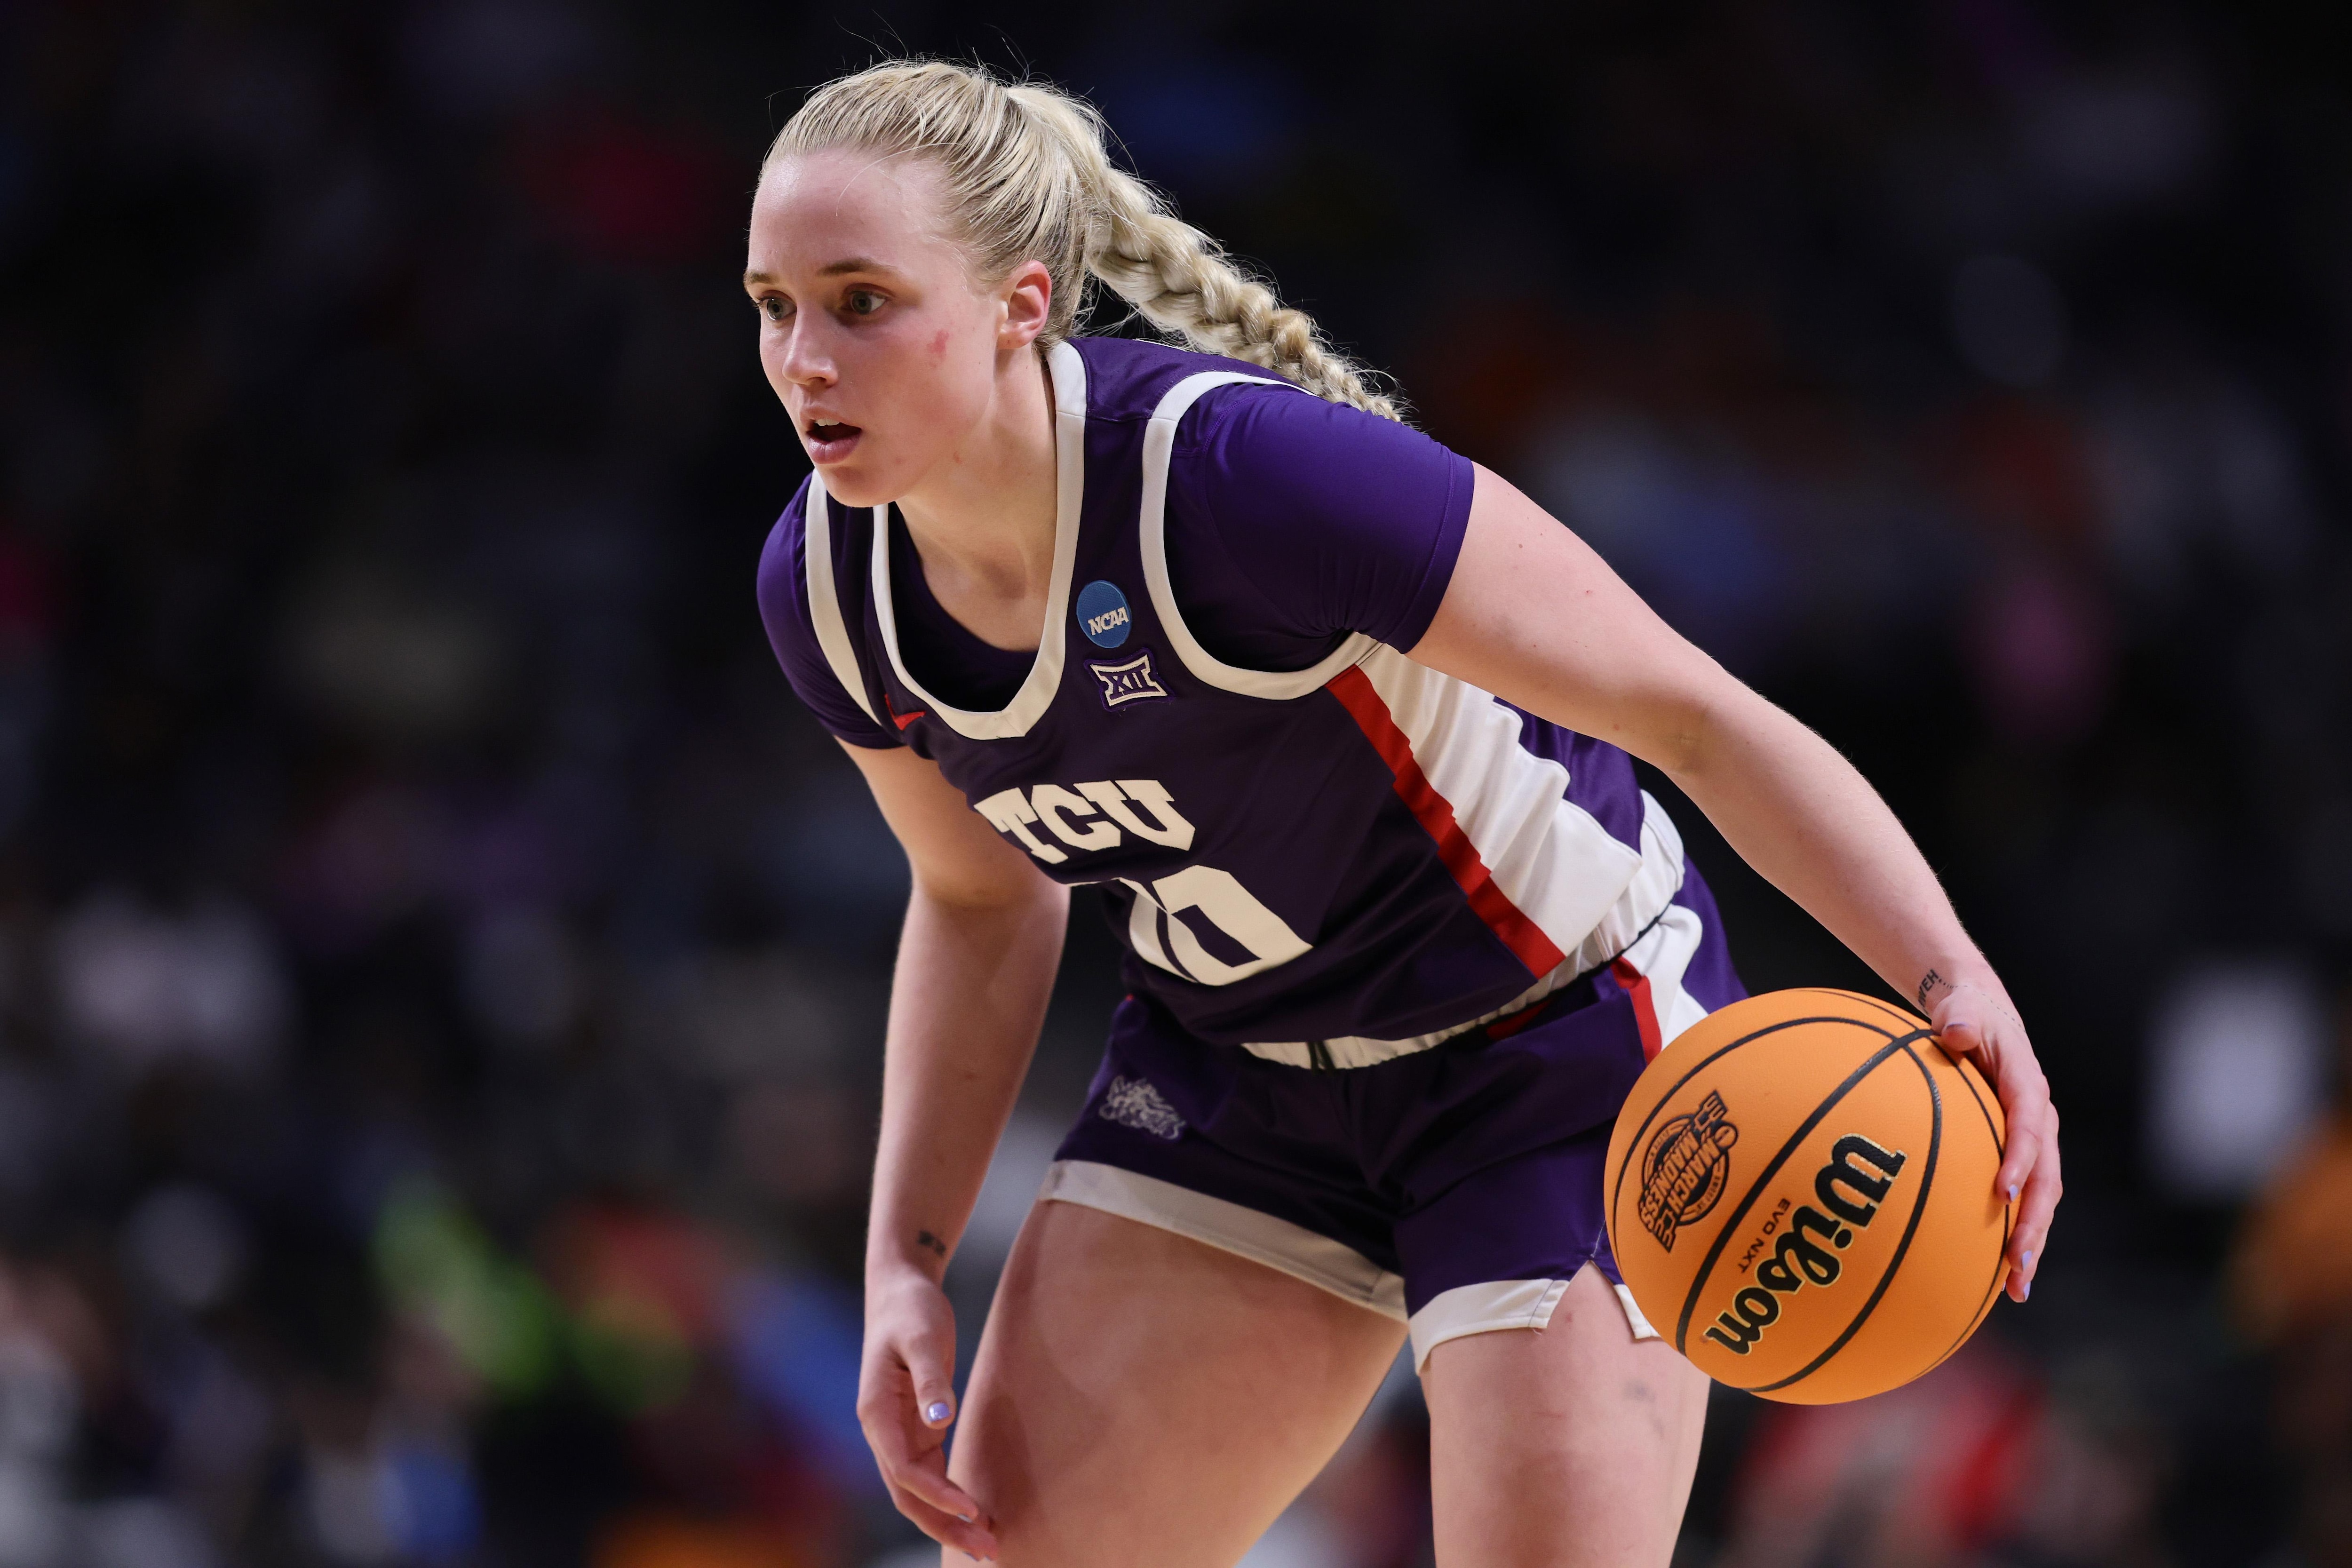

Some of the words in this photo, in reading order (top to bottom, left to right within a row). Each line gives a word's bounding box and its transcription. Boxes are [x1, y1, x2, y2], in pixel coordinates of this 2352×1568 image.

[1088, 606, 1129, 636] NCAA
[1097, 661, 1161, 701] XII
[974, 779, 1196, 864] TCU
[1640, 1130, 1700, 1230] MADNESS
[1666, 1136, 1721, 1216] MARCH
[1704, 1132, 1907, 1355] Wilson
[1762, 1198, 1791, 1236] EVO
[1738, 1238, 1764, 1274] NXT
